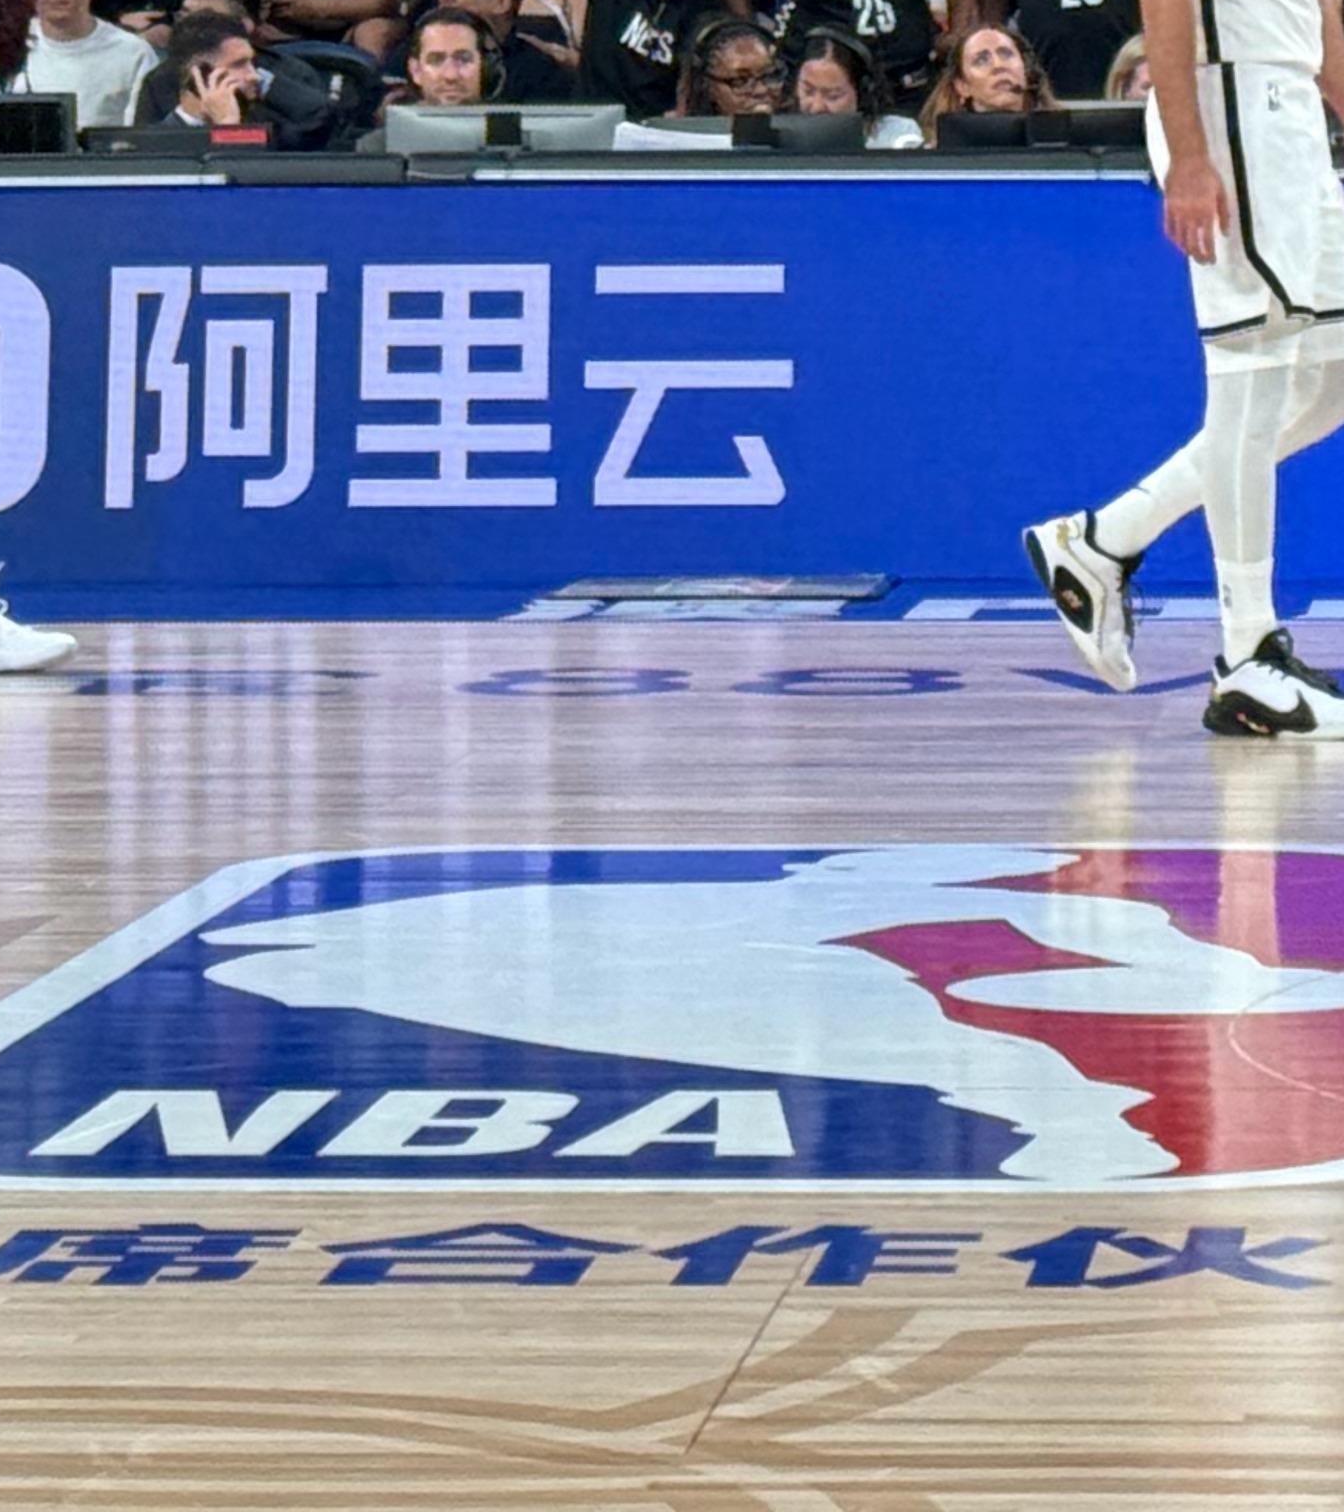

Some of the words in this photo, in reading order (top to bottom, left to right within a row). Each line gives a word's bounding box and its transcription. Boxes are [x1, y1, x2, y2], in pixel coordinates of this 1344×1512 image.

[104, 262, 794, 509] 阿里云
[28, 1089, 798, 1160] NBA
